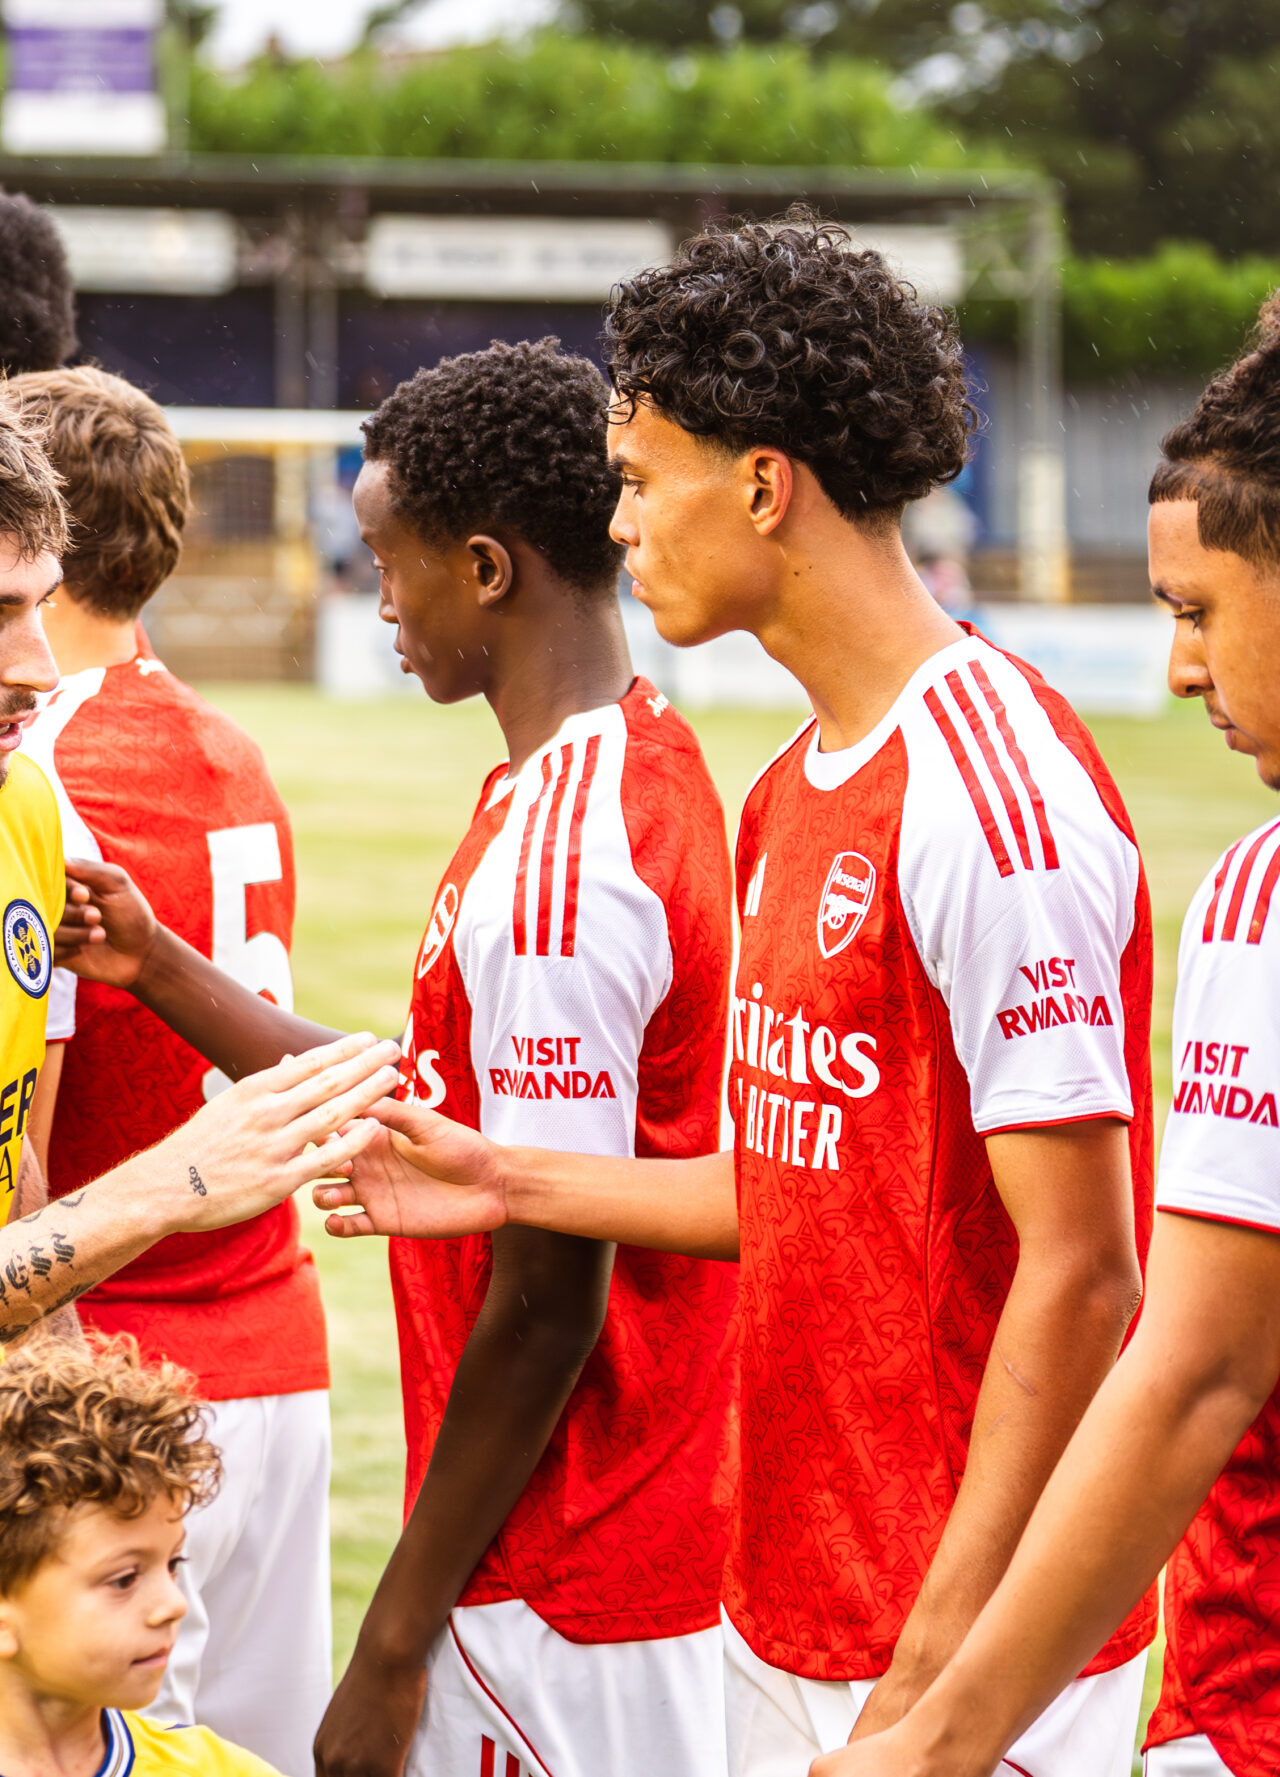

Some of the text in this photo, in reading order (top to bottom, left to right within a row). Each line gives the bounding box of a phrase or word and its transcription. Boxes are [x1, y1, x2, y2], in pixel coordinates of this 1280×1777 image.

[202, 822, 294, 1103] 5
[511, 1035, 581, 1066] VISIT
[488, 1068, 617, 1100] RWANDA
